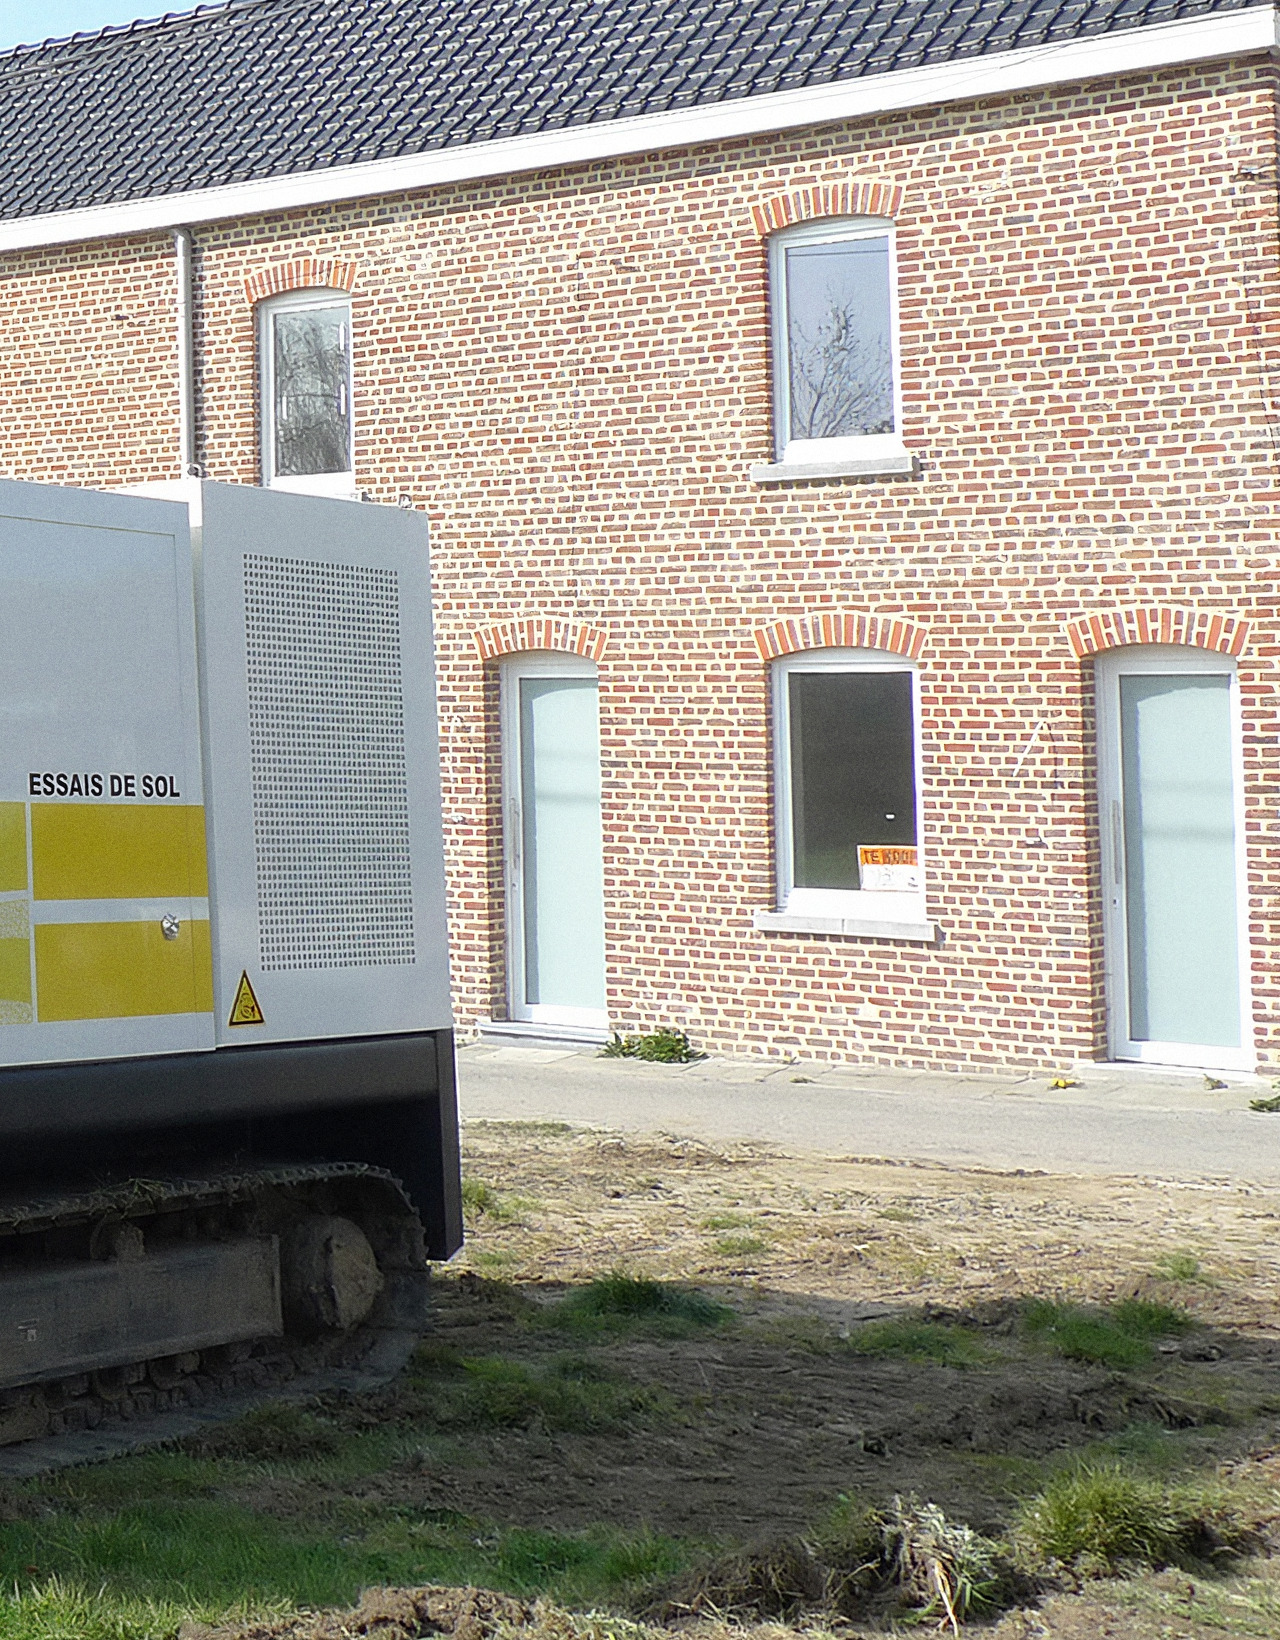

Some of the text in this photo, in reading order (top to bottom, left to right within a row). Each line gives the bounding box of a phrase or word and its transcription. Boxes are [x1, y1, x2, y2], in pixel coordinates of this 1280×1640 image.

[28, 772, 181, 798] ESSAIS DE SOL
